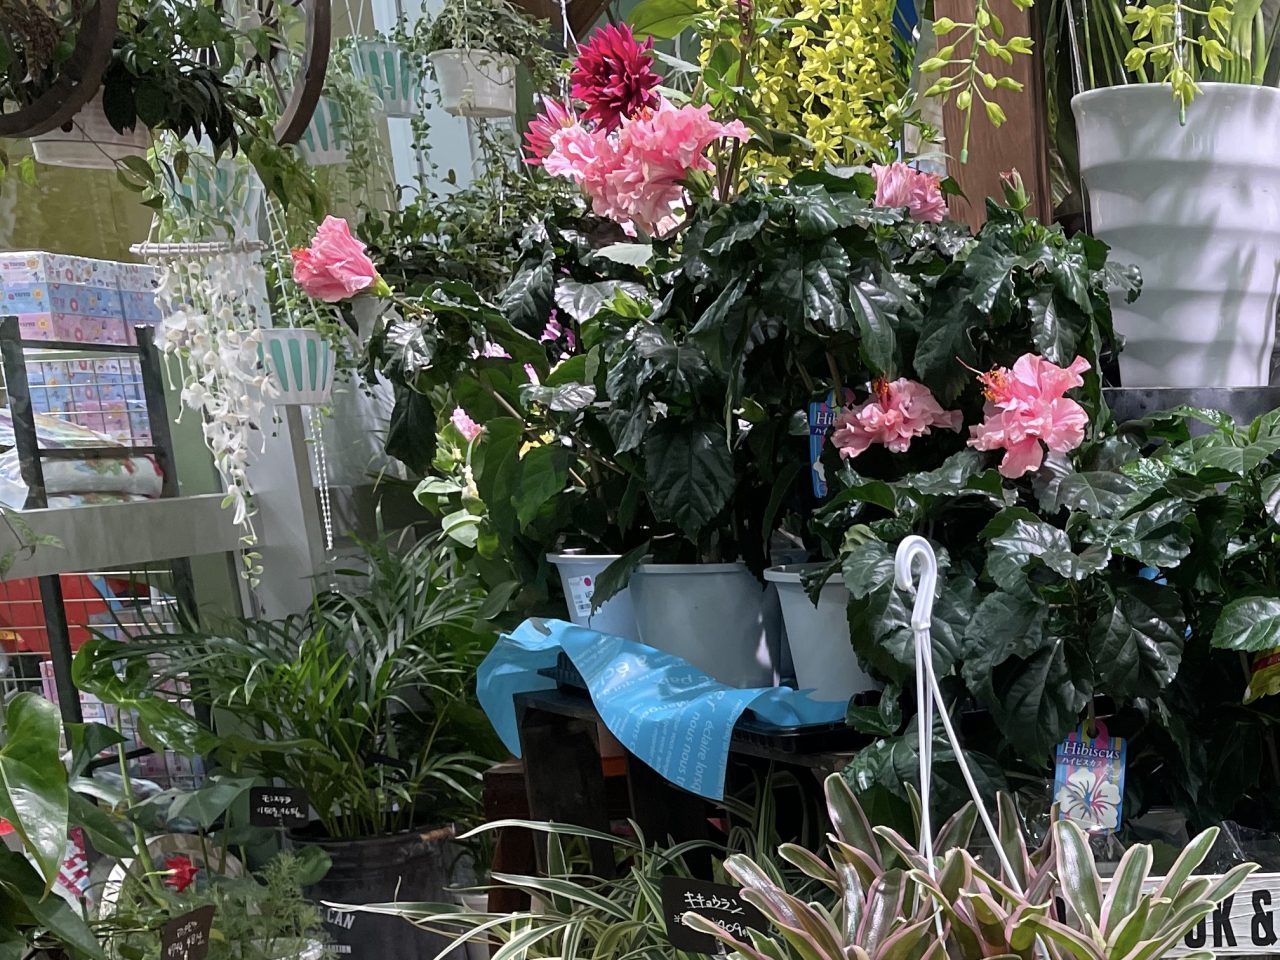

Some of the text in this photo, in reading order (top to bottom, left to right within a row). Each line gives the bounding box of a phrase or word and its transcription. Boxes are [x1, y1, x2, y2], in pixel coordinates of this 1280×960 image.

[1063, 741, 1121, 760] Hibiscus
[327, 907, 356, 930] CAN
[1250, 888, 1278, 947] &
